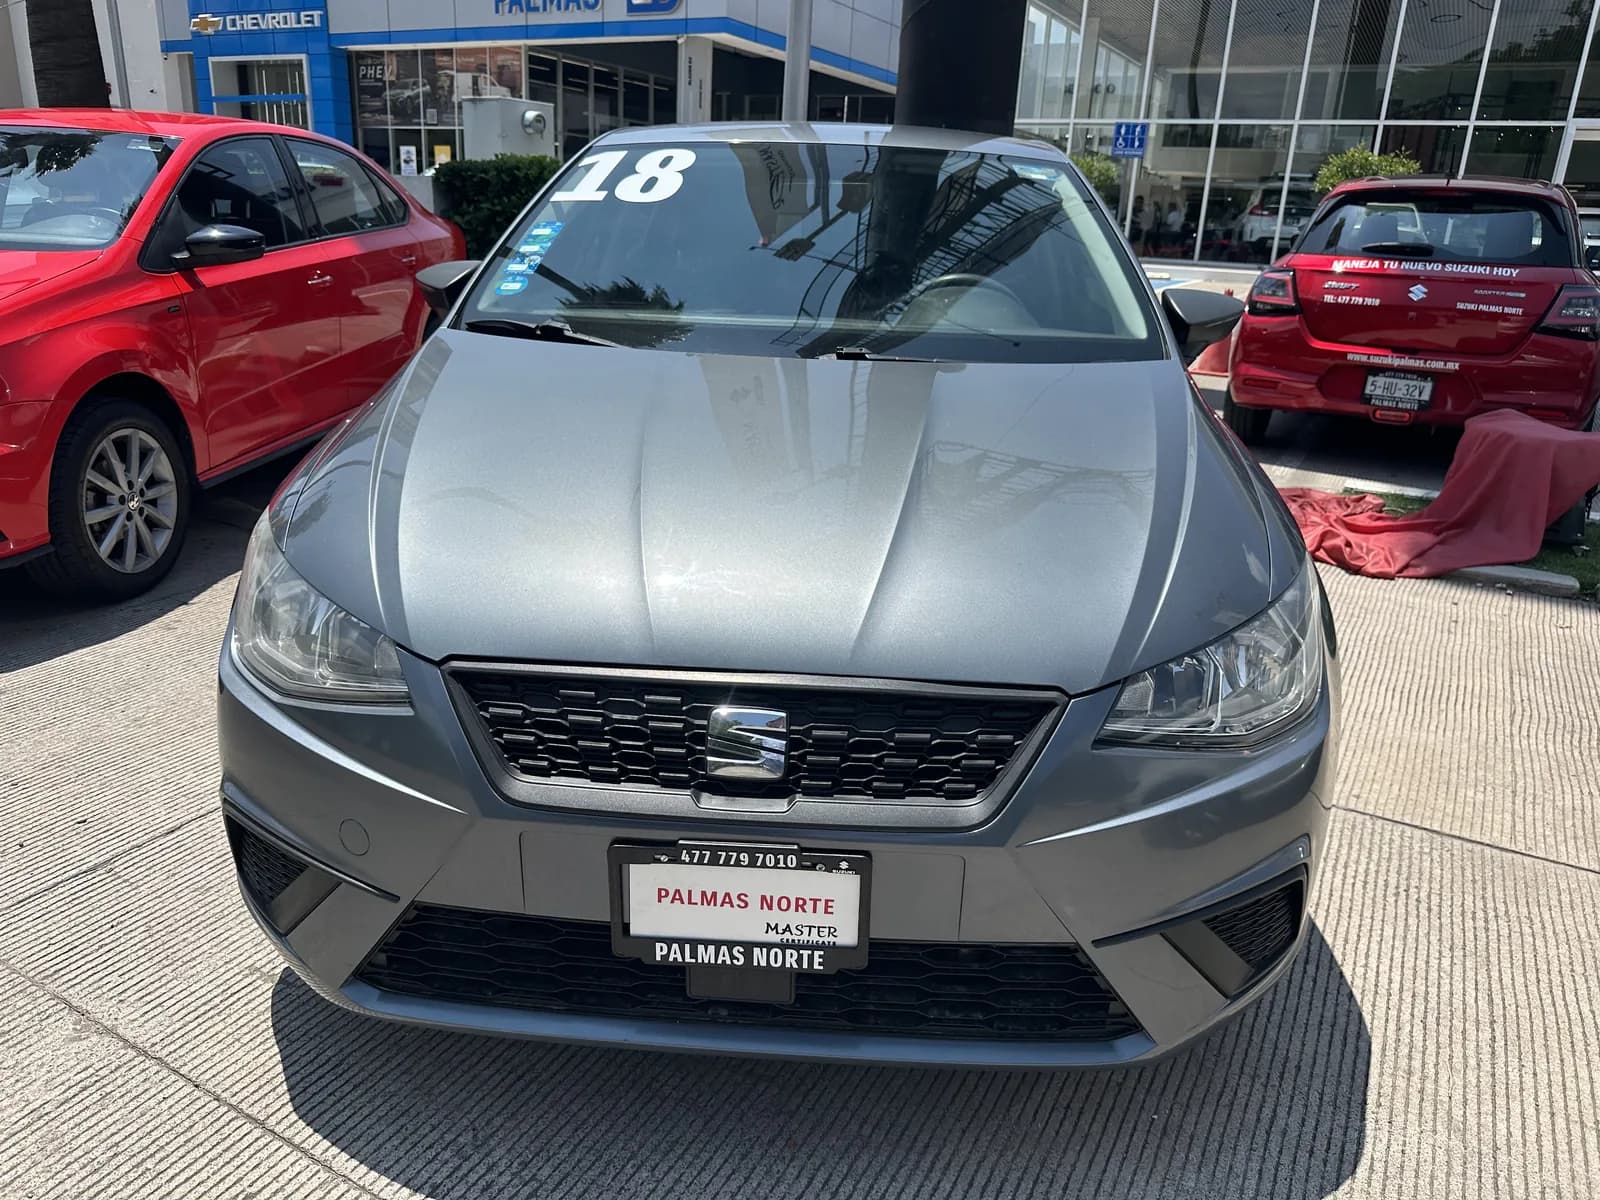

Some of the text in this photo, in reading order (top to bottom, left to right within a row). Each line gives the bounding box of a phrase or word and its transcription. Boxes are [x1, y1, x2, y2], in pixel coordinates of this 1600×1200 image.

[226, 11, 323, 31] CHEVROLET
[550, 148, 697, 203] 18
[1332, 260, 1520, 277] MANEJA TU NUEVO SUZUKI HOY
[1323, 294, 1337, 303] TEL:
[1456, 302, 1523, 315] SUZUKI PALMAS NORTE
[1346, 353, 1459, 370] www.suzukipalmas.com.mx
[681, 849, 797, 868] 477 779 7010
[657, 887, 834, 915] PALMAS NORTE
[765, 922, 838, 938] MASTER
[655, 942, 825, 970] PALMAS NORTE
